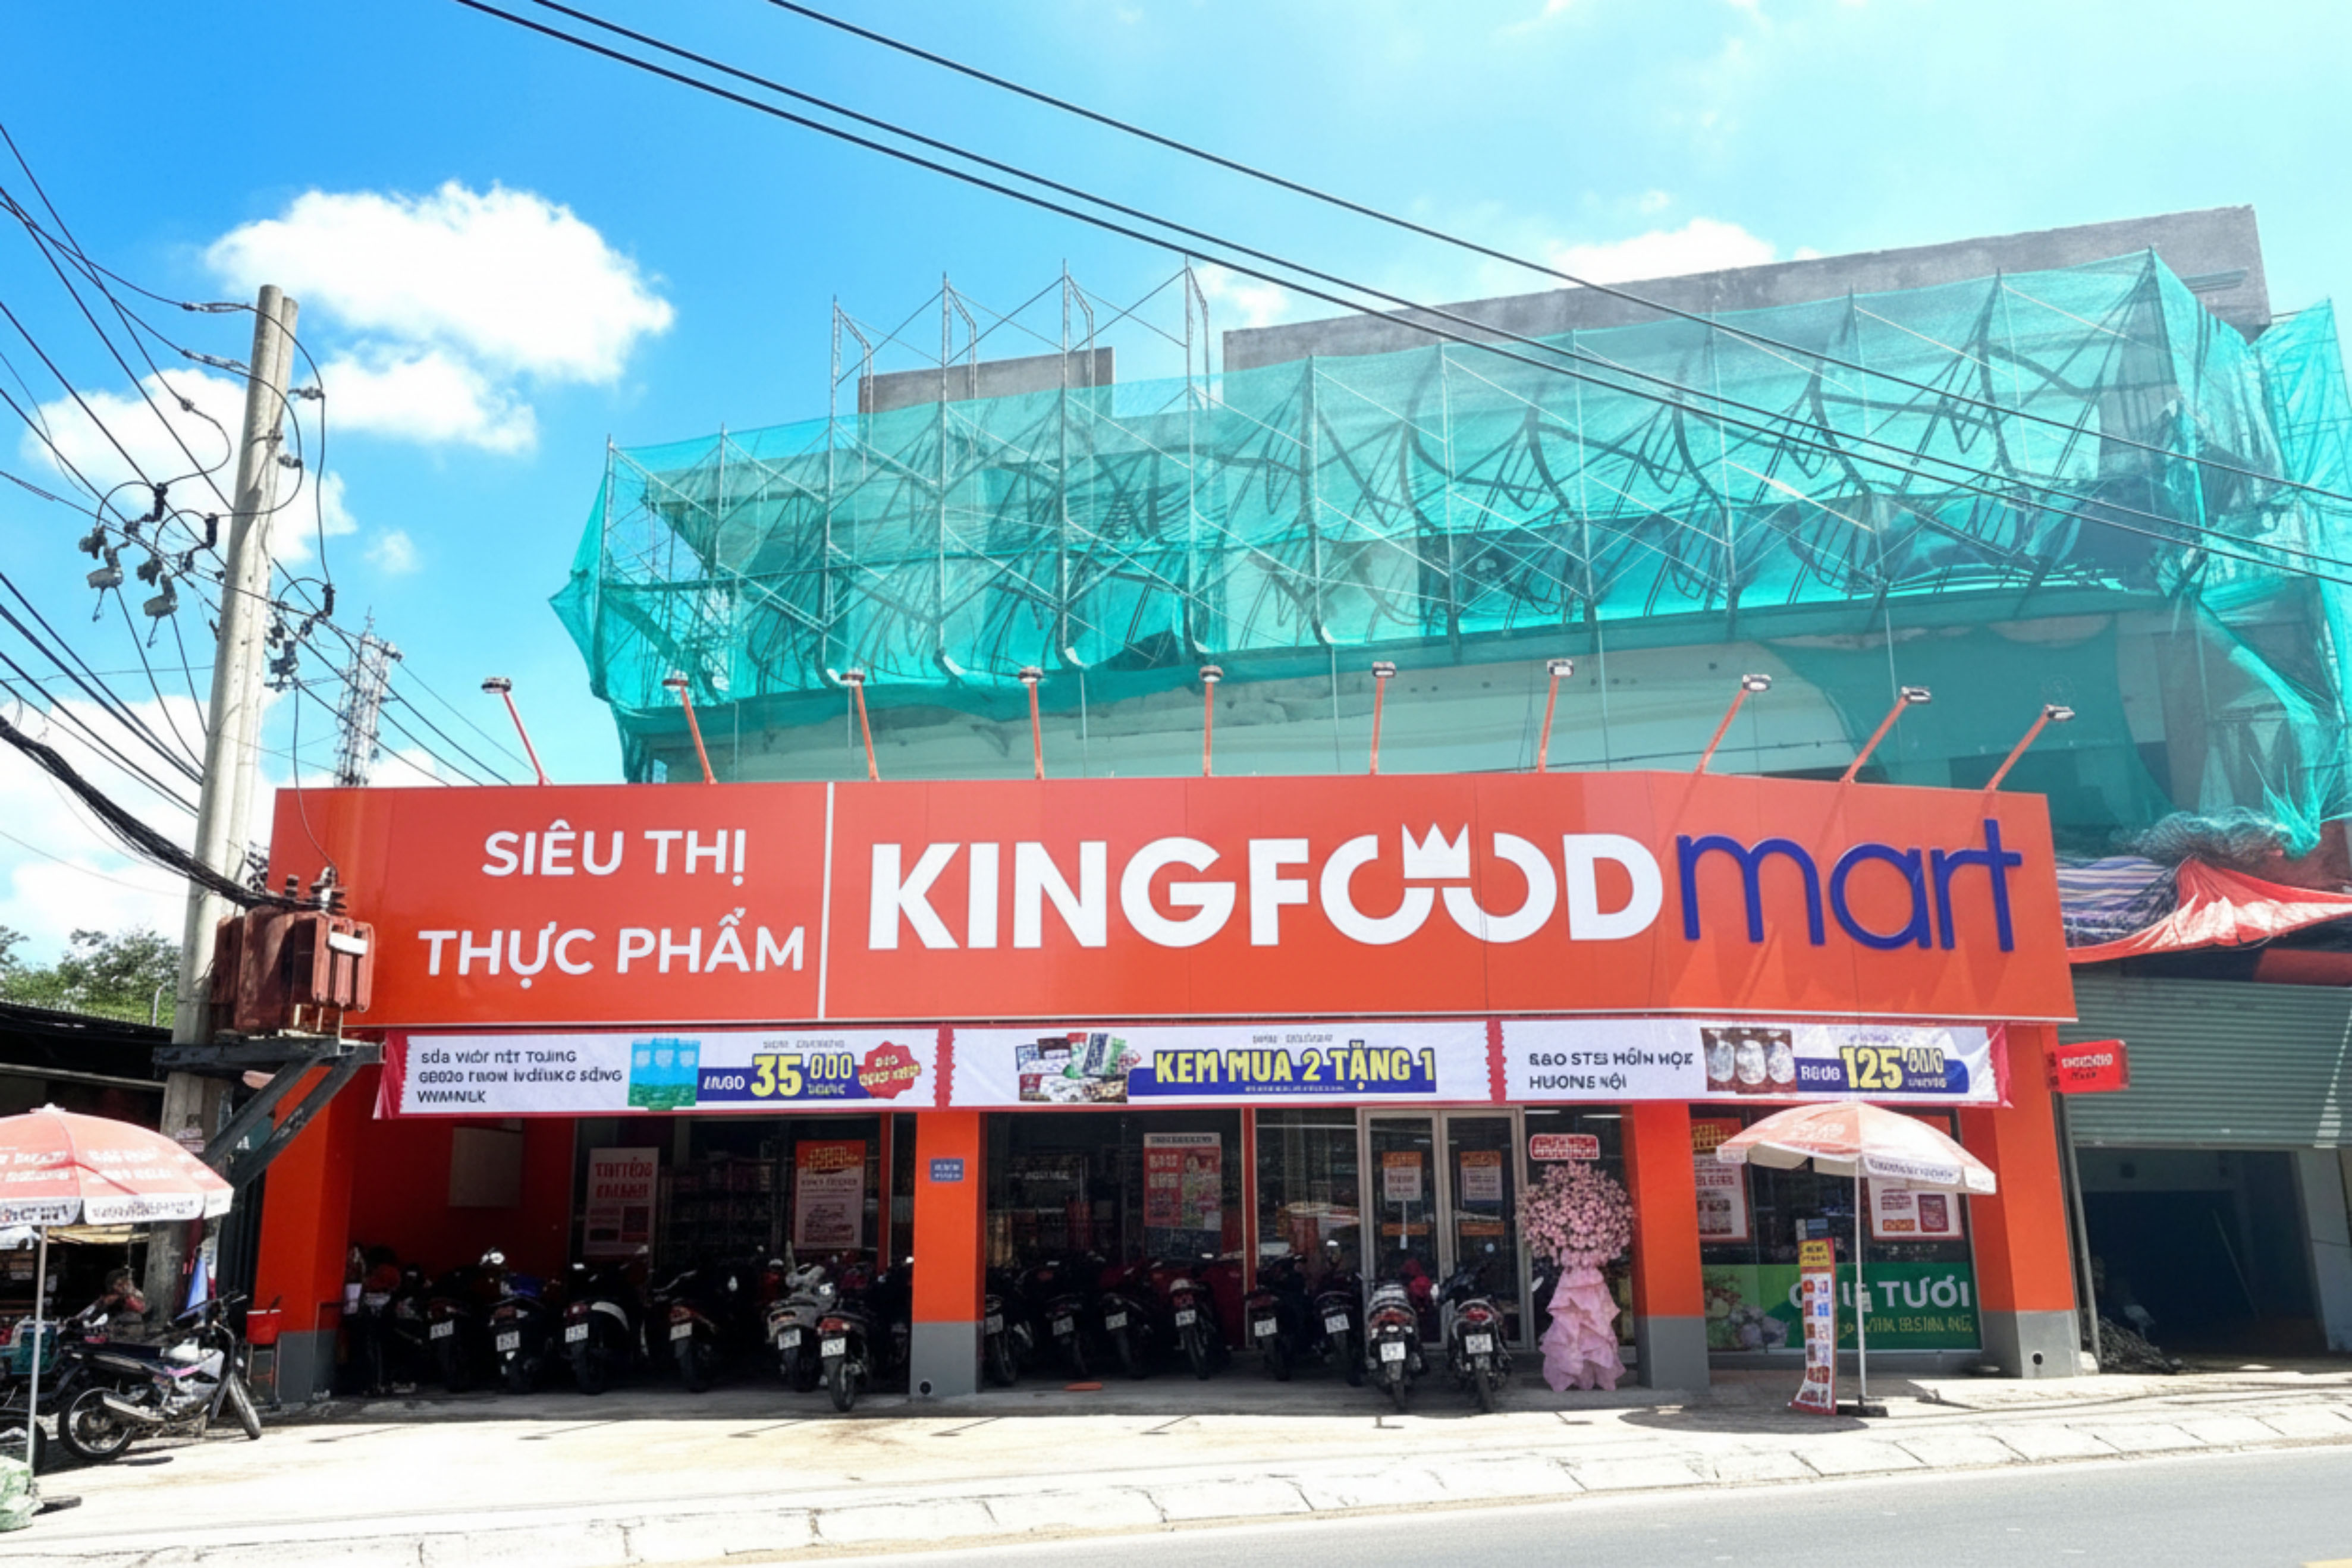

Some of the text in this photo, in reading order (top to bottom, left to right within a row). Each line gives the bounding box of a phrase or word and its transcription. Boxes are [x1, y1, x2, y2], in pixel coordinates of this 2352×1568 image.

[481, 819, 747, 887] SIÊU THỊ
[417, 907, 806, 989] THỰC PHẨM
[750, 1054, 803, 1097] 35
[1154, 1050, 1219, 1083] KEM
[1227, 1050, 1293, 1082] MUA
[1302, 1050, 1321, 1082] 2
[1420, 1049, 1435, 1080] 1
